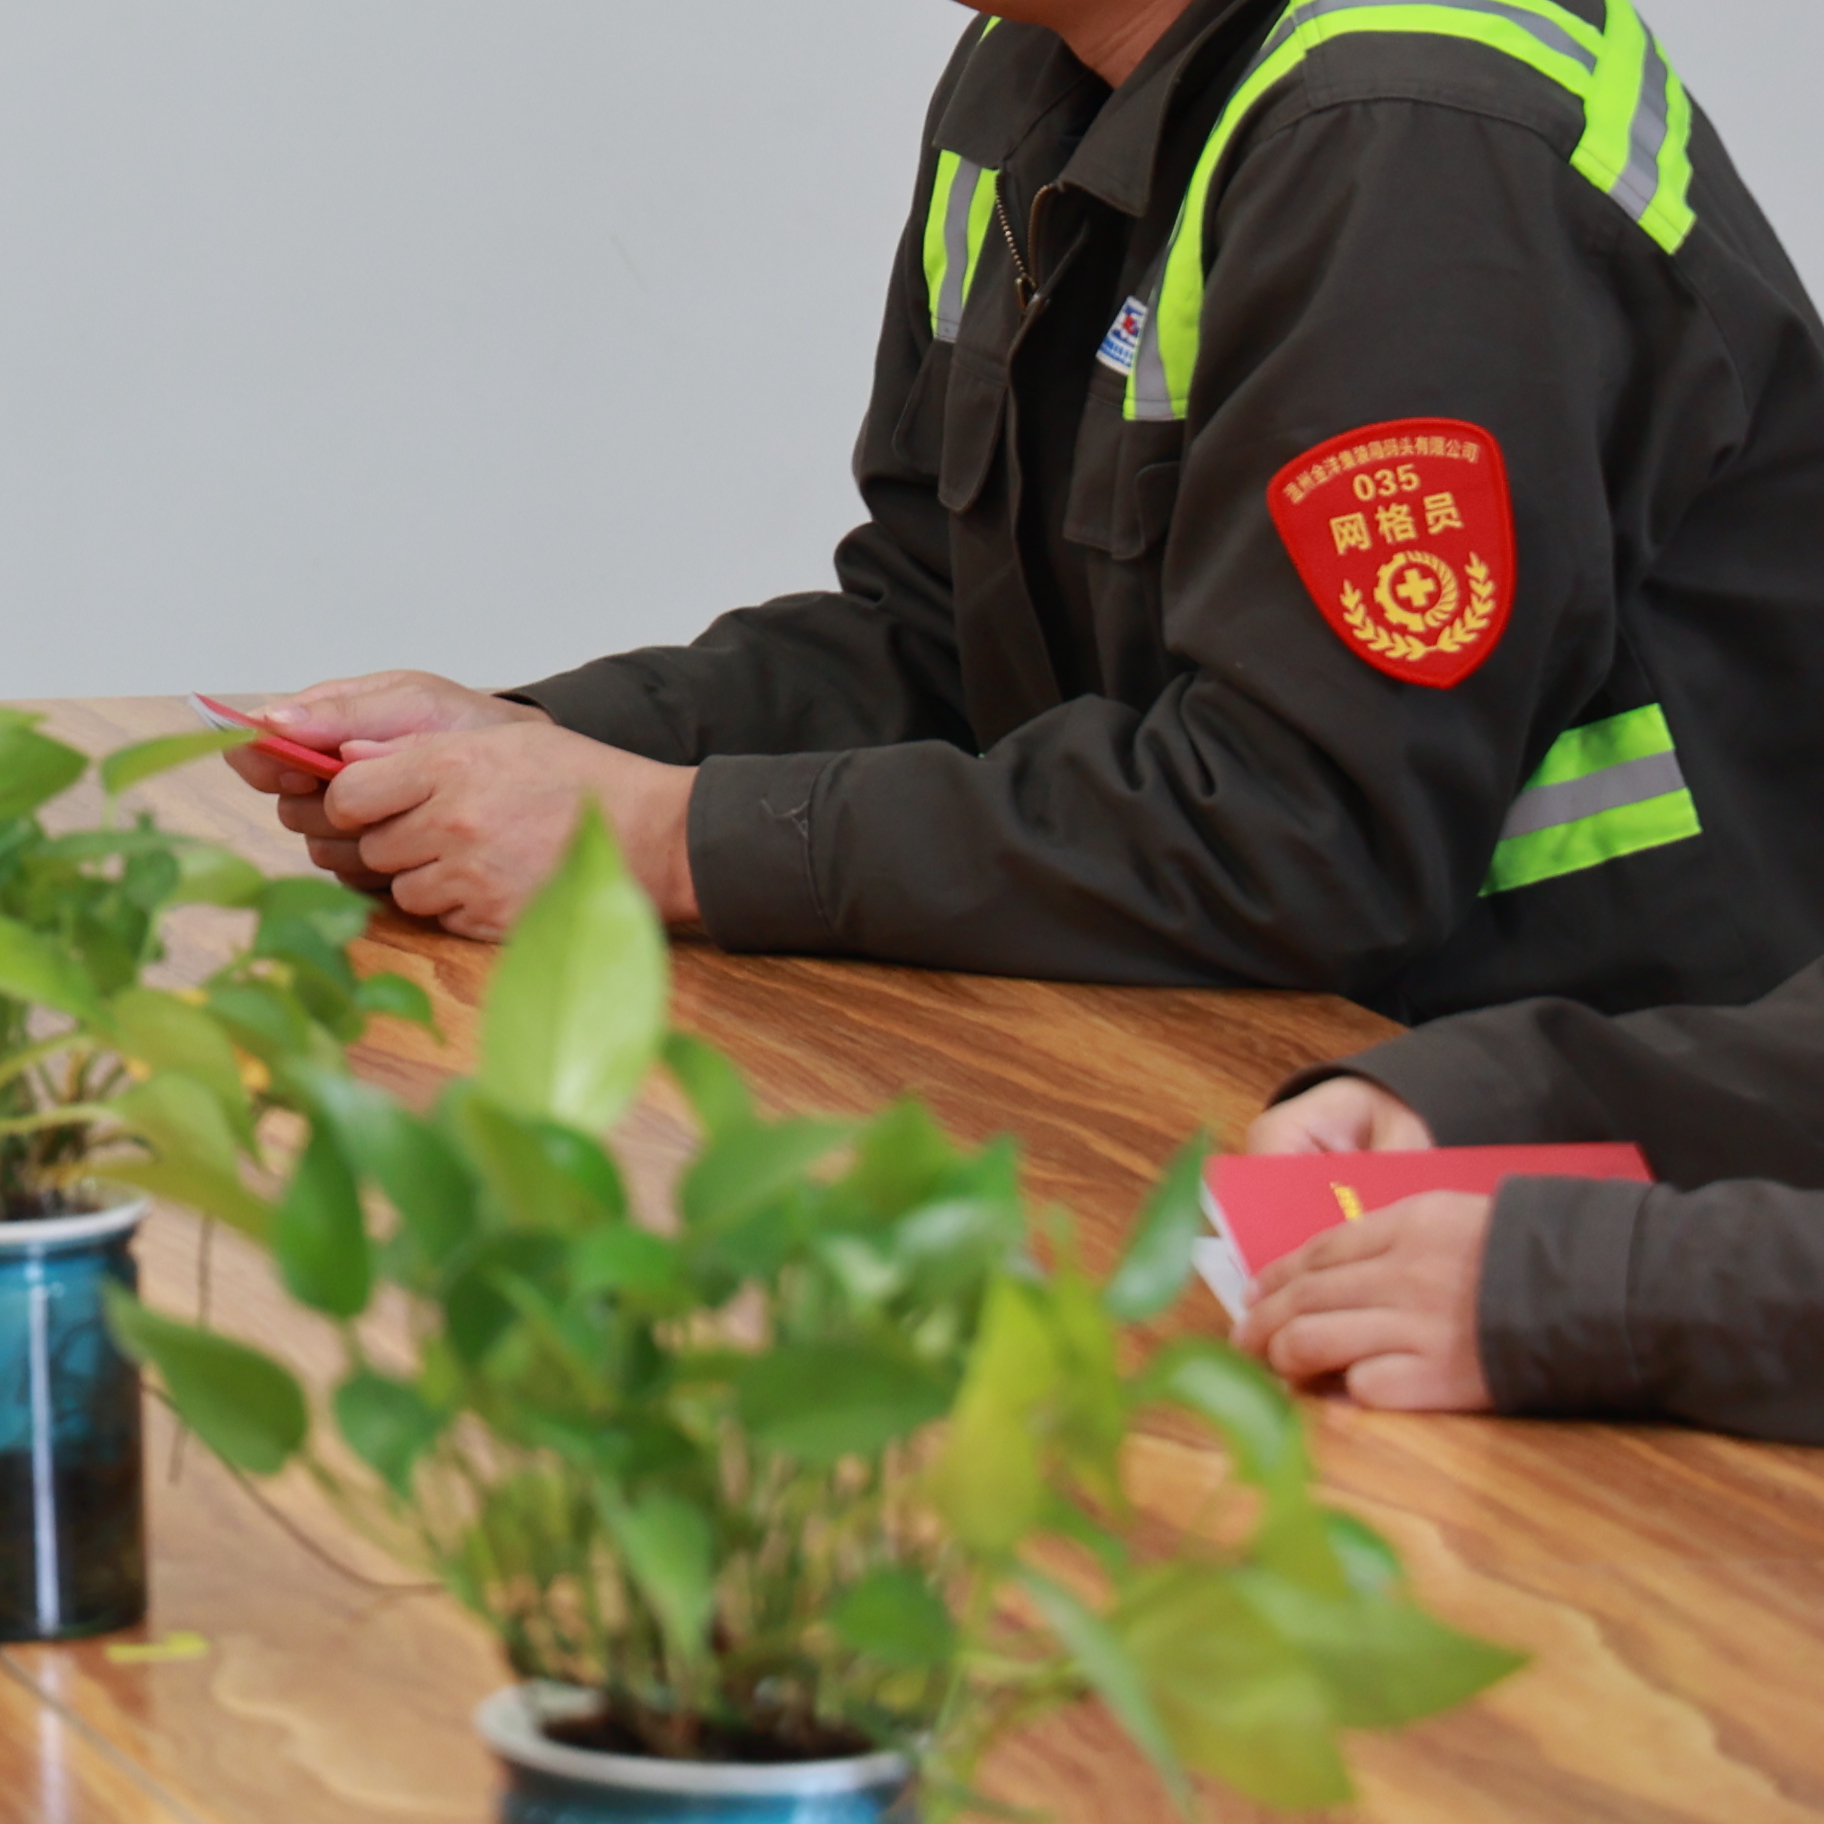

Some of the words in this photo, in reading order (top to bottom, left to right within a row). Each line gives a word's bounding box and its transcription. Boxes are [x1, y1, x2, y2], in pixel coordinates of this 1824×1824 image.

[1352, 462, 1422, 502] 035
[1328, 490, 1465, 556] 网格员
